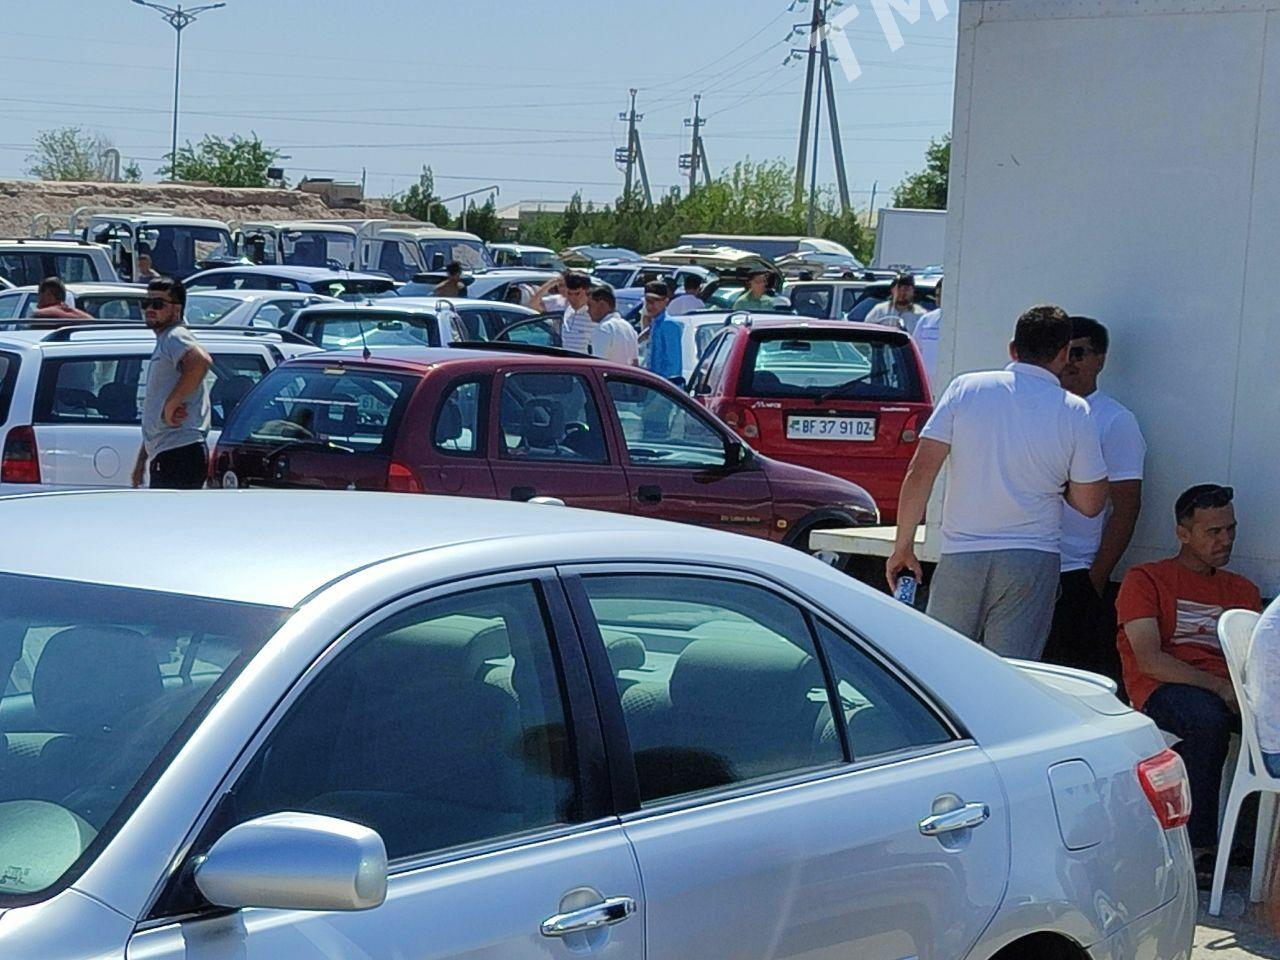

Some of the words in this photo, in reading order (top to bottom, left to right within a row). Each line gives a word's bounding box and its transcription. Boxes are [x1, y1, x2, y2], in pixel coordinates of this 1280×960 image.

[802, 419, 817, 434] BF
[819, 419, 836, 434] 37
[839, 420, 854, 435] 91
[857, 421, 870, 436] DZ
